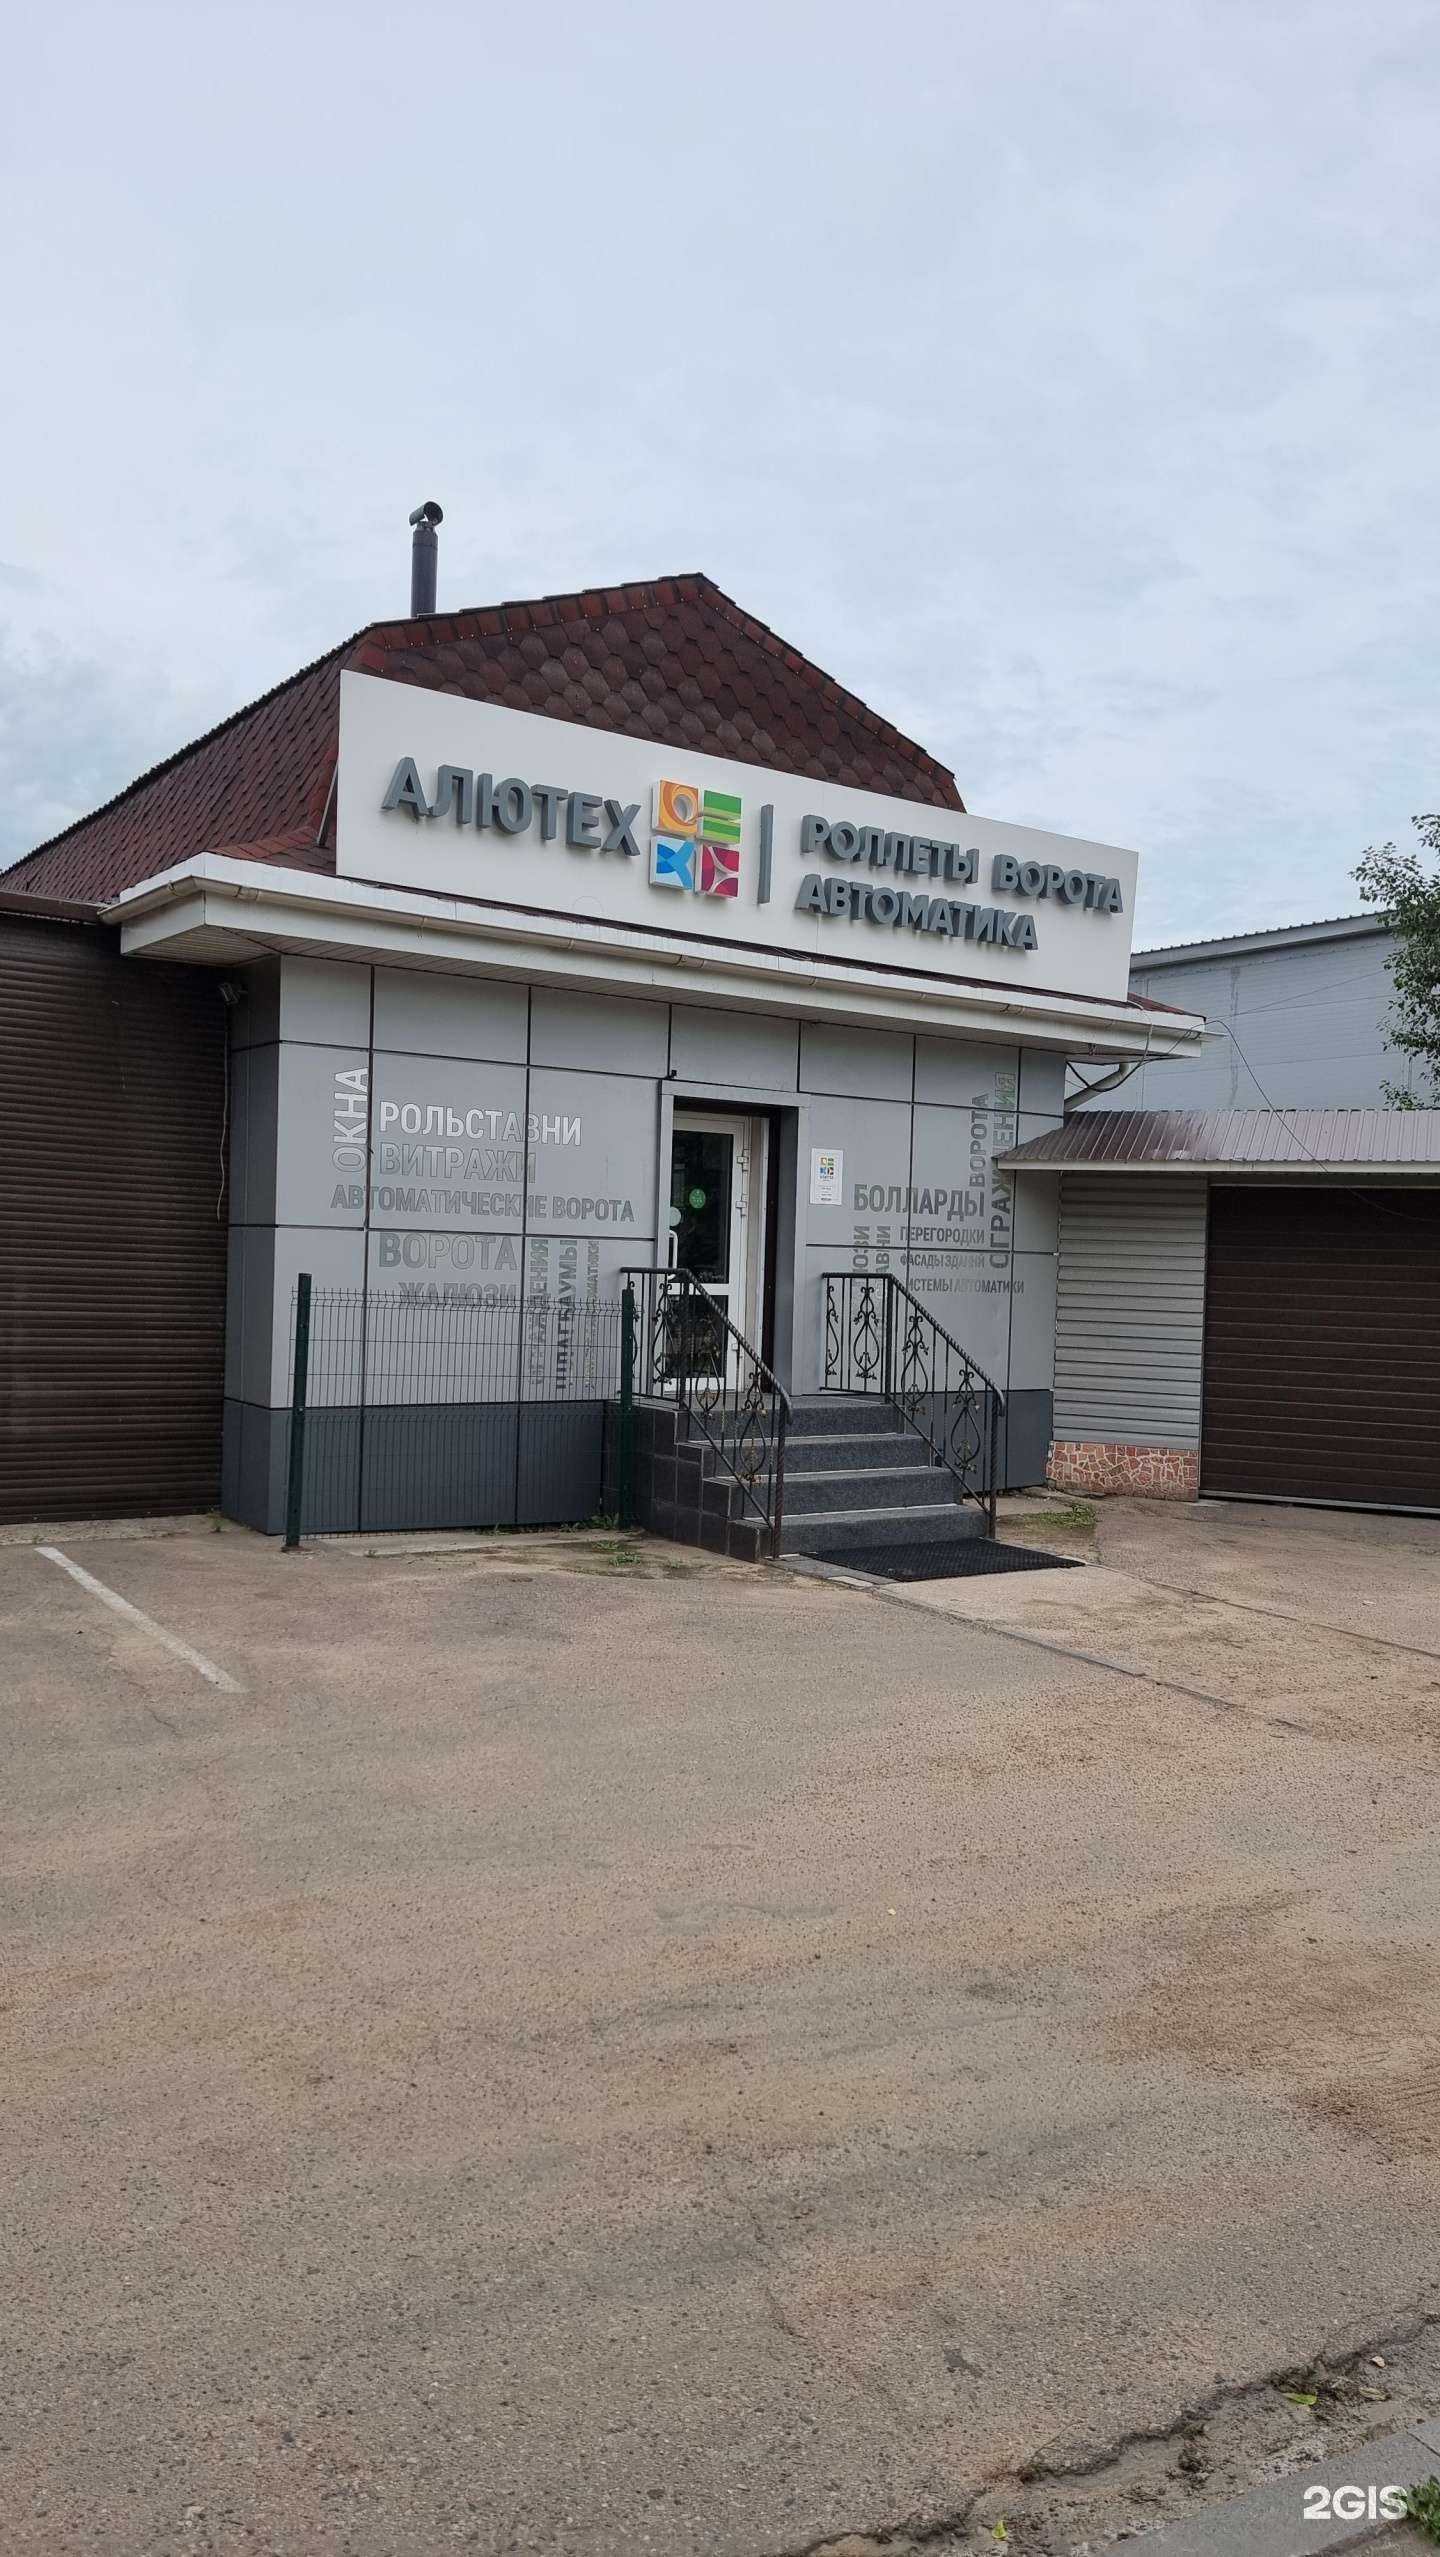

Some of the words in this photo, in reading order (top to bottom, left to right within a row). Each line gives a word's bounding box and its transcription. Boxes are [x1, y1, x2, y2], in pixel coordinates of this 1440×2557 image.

[381, 757, 641, 857] АЛЮТЕХ
[801, 814, 979, 884] РОЛЛЕТЫ
[991, 854, 1123, 913] ВОРОТА
[795, 873, 1038, 950] АВТОМАТИКА
[331, 1067, 369, 1172] ОКНА
[379, 1100, 582, 1146] РОЛЬСТАВНИ
[968, 1093, 989, 1188] ВОРОТА
[379, 1142, 536, 1183] ВИТРАЖИ
[989, 1072, 1016, 1269] ОГРАЖЕНИЯ
[330, 1184, 547, 1219] АВТОМАТИЧЕСКИЕ
[552, 1198, 635, 1222] ВОРОТА
[853, 1183, 985, 1222] БОЛЛАРДЫ
[378, 1233, 517, 1270] ВОРОТА
[900, 1226, 985, 1246] ПЕРЕГОРОДКИ
[905, 1277, 952, 1292] ИСТЕМЫ
